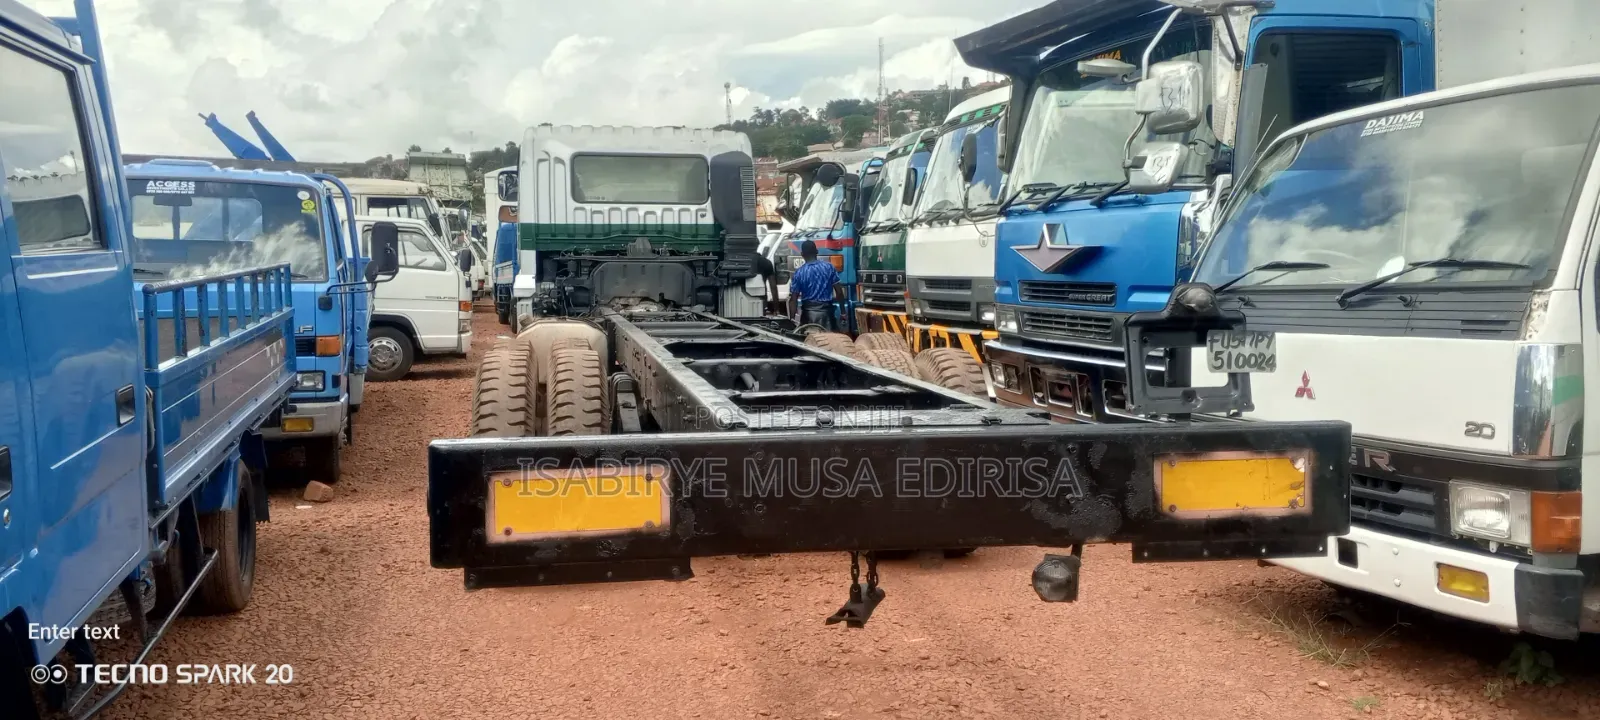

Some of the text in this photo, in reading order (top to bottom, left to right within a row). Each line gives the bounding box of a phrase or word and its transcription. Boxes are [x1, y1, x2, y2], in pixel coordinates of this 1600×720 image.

[1365, 111, 1424, 129] DAJIMA
[146, 180, 195, 188] ACCESS
[862, 273, 903, 284] FUSO
[1086, 294, 1111, 302] GREAT
[1211, 350, 1277, 371] 510024
